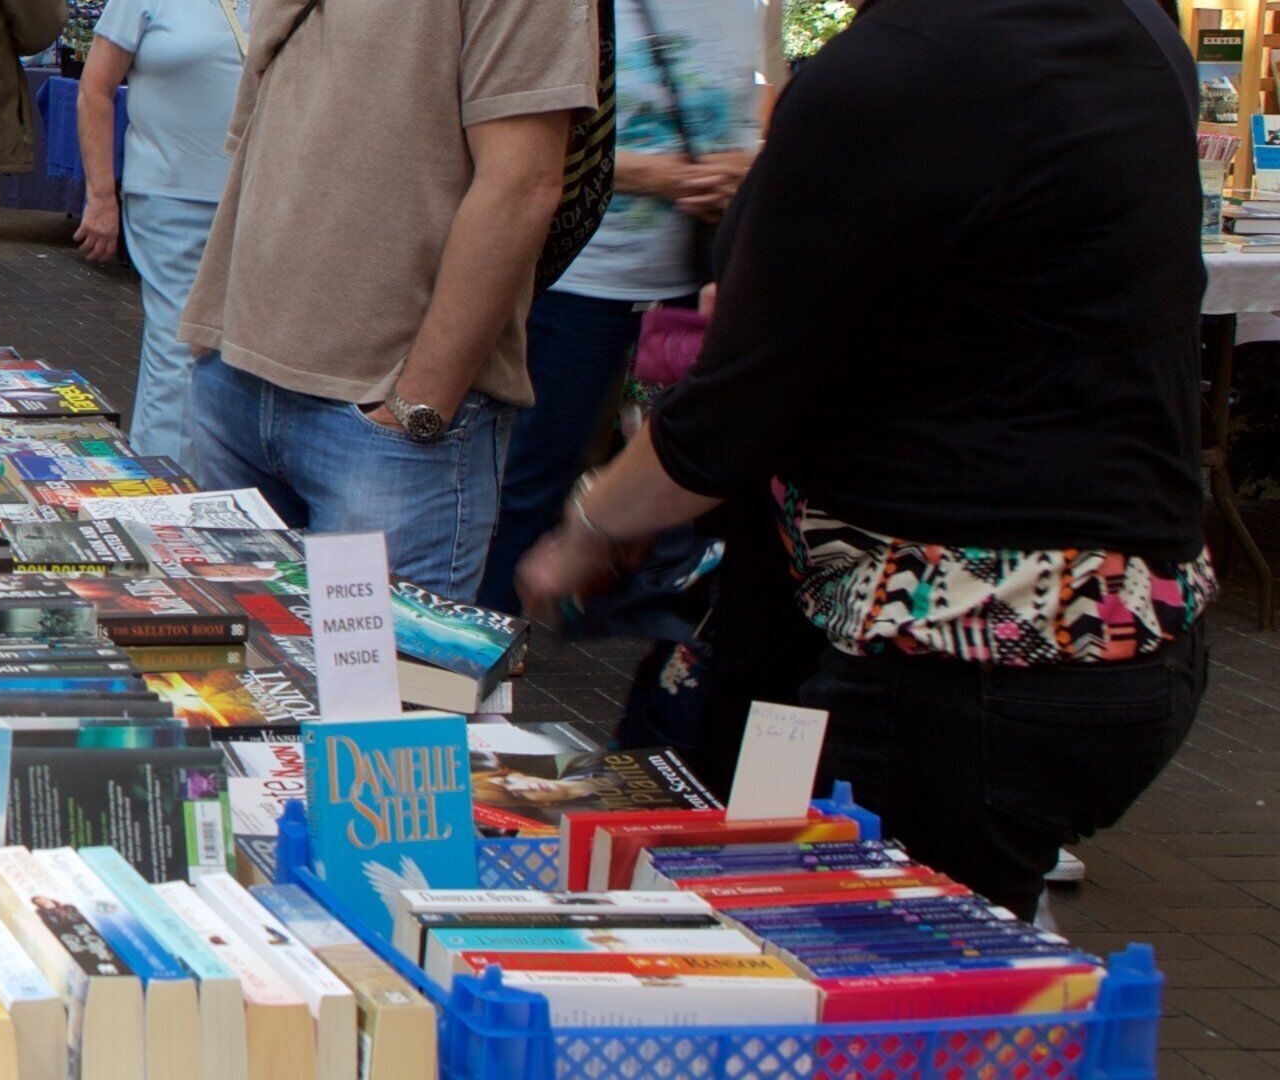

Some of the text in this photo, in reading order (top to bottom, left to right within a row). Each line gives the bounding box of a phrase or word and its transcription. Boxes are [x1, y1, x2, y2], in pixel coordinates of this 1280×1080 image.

[1203, 36, 1242, 45] EXETER
[326, 583, 373, 599] PRICES
[131, 624, 189, 637] SKELETON
[191, 624, 224, 636] ROOM
[323, 616, 383, 634] MARKED
[333, 649, 380, 666] INSIDE
[248, 669, 322, 722] POINT
[326, 735, 466, 804] DANIELLE
[648, 754, 691, 792] Scream
[603, 754, 674, 804] Plante
[347, 793, 453, 850] STEEL
[417, 890, 531, 904] DANIELLE STEEL
[738, 884, 784, 895] Summers
[683, 956, 774, 970] RANSOM
